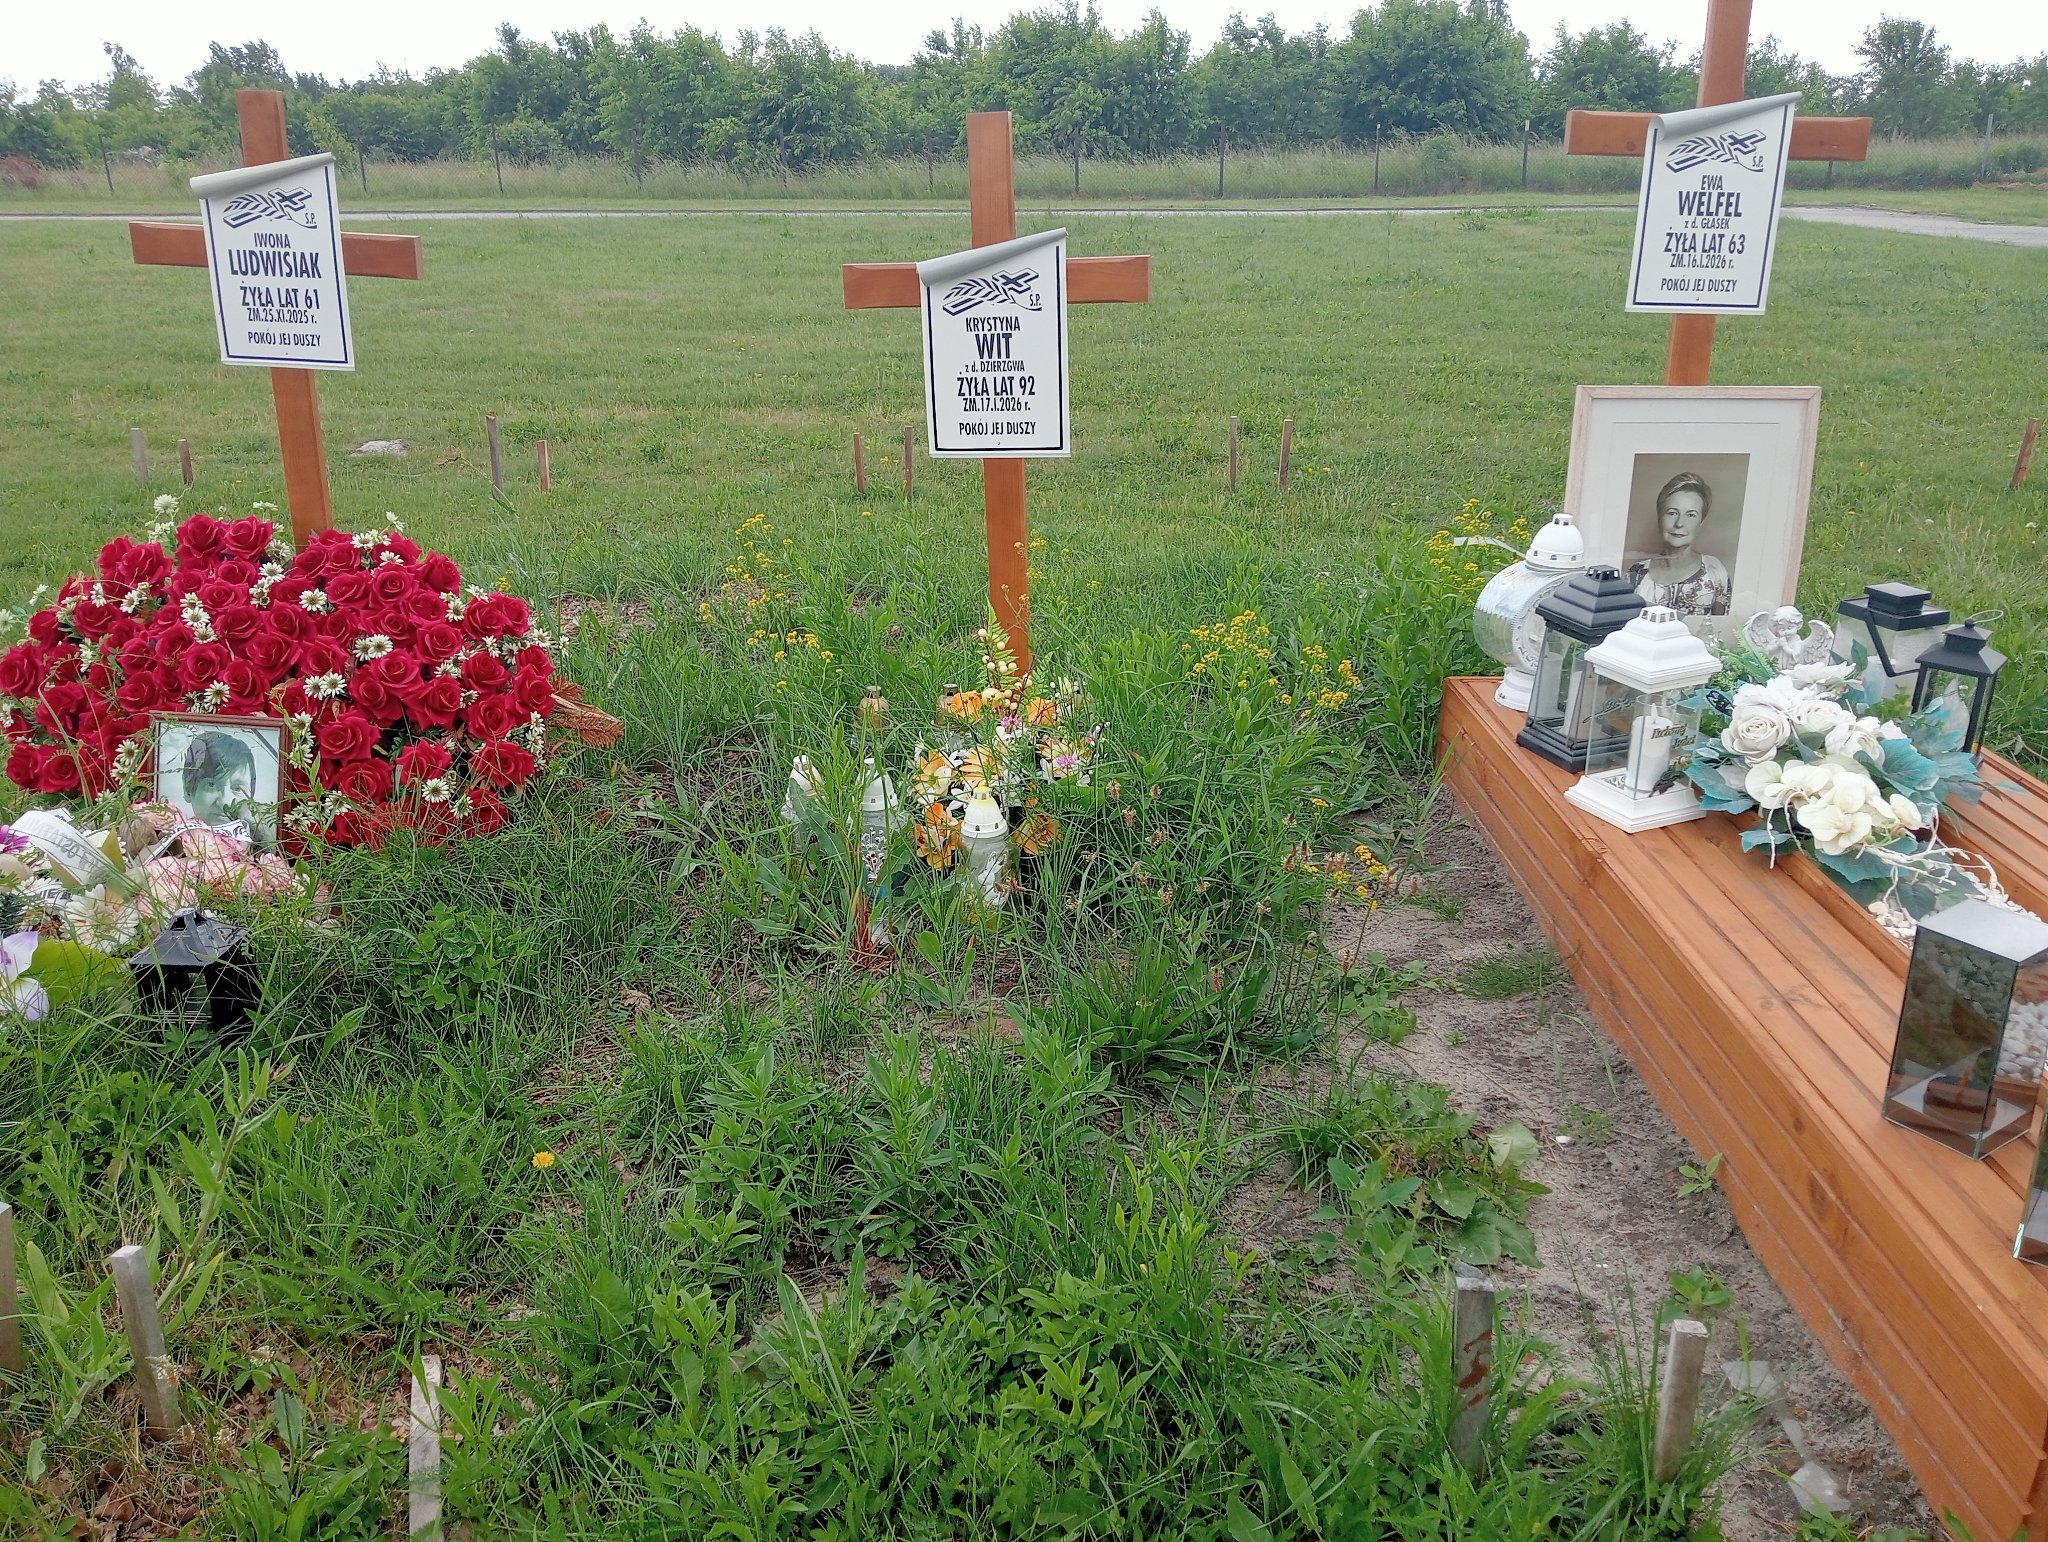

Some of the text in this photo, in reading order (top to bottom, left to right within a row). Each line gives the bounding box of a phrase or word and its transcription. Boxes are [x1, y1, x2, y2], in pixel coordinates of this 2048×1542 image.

[1701, 175, 1723, 191] EWA
[1678, 191, 1743, 217] WELFEL
[1684, 220, 1689, 229] z
[1701, 218, 1730, 230] GŁASEK
[254, 233, 291, 249] IWONA
[1664, 227, 1746, 254] ŻYŁA LAT 63
[228, 249, 322, 279] LUDWISIAK
[1670, 253, 1734, 269] ZM.16.I.2026 r.
[1661, 275, 1738, 293] POKÓJ JEJ DUSZY
[240, 281, 320, 310] ŻYŁA LAT 61
[247, 307, 317, 325] ZM.25.XI.2025 r.
[965, 316, 1021, 332] KRYSTYNA
[248, 329, 321, 347] POKÓJ JEJ DUSZY
[975, 333, 1013, 359] WIT
[965, 364, 970, 373] z
[980, 360, 1025, 372] DZIERZGWA
[957, 370, 1036, 397] ŻYŁA LAT 92
[963, 397, 1030, 412] ZM.17.I.2026 r.
[959, 418, 1036, 436] POKÓJ JEJ DUSZY
